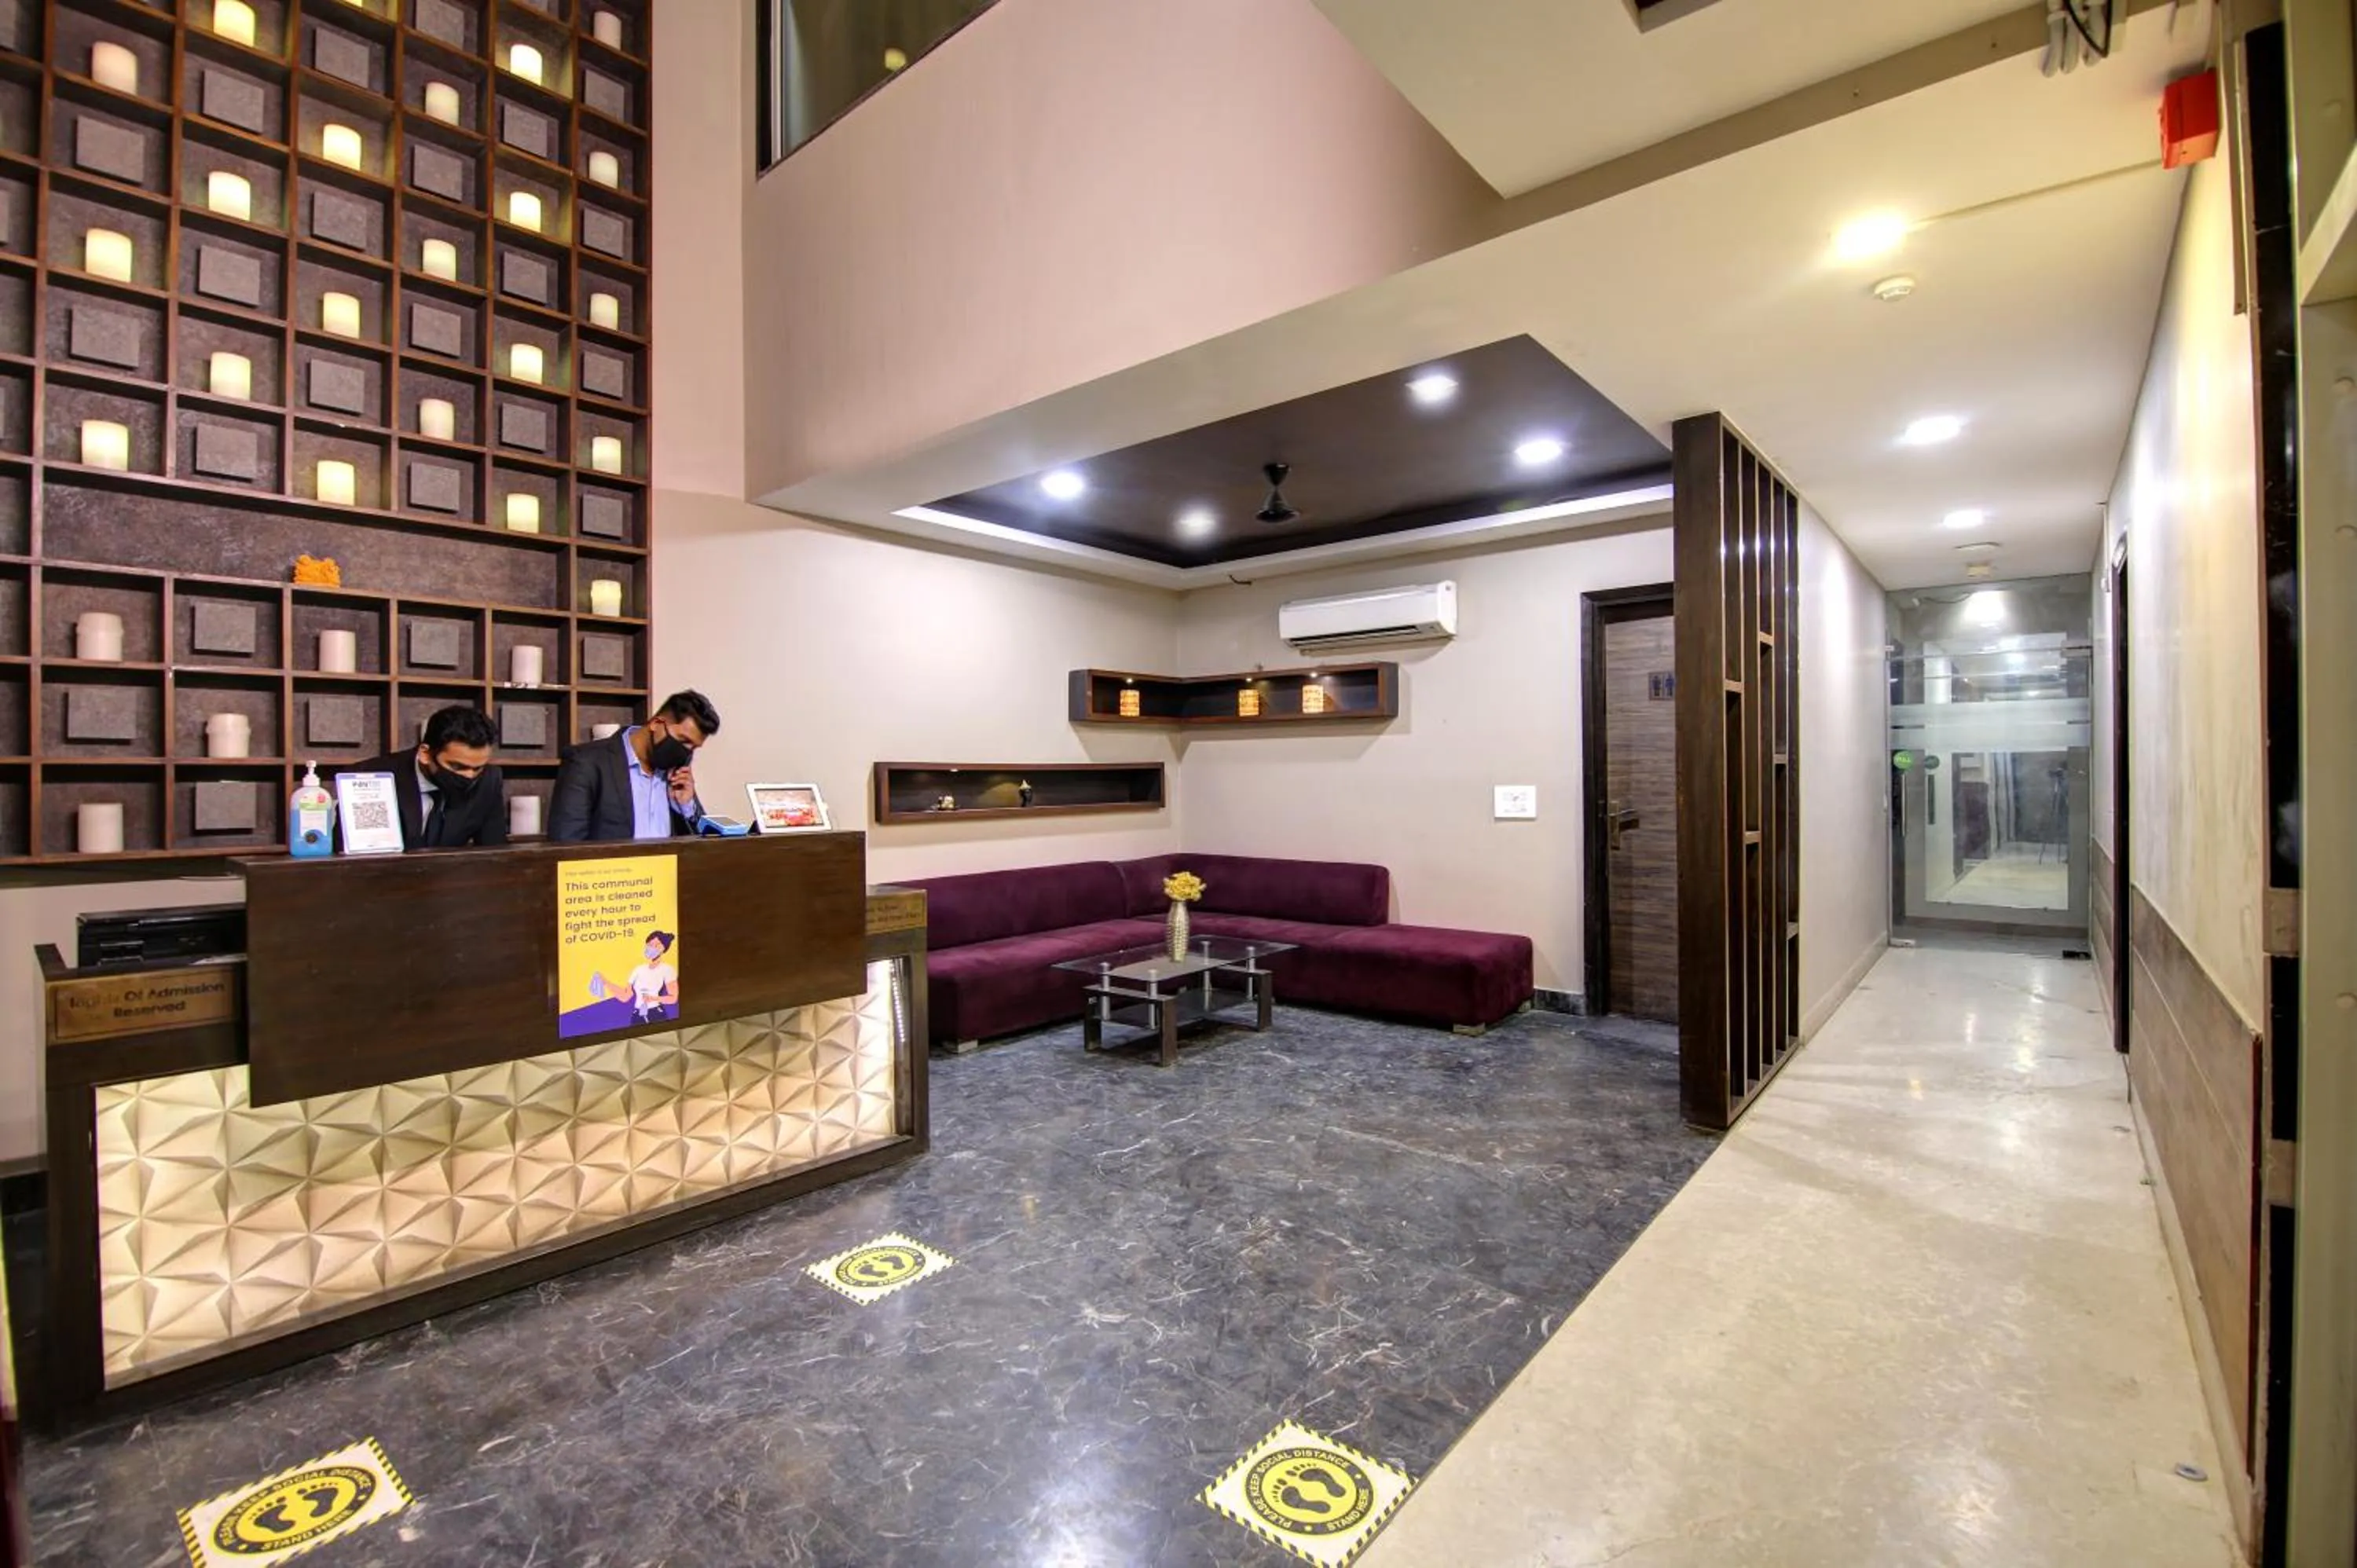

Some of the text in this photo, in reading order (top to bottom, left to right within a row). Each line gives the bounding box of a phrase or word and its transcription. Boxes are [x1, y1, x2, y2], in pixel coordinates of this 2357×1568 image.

[565, 876, 653, 892] This communal
[565, 889, 653, 904] area is cleaned
[565, 907, 597, 918] every
[601, 906, 627, 914] hour
[565, 914, 656, 932] fight the spread
[565, 928, 634, 943] of COVID-19
[147, 982, 225, 1000] Admission
[113, 1000, 186, 1018] Reserved
[1250, 1449, 1349, 1530] PLEASE KEEP SOCIAL DISTANCE
[1325, 1510, 1360, 1531] STAND
